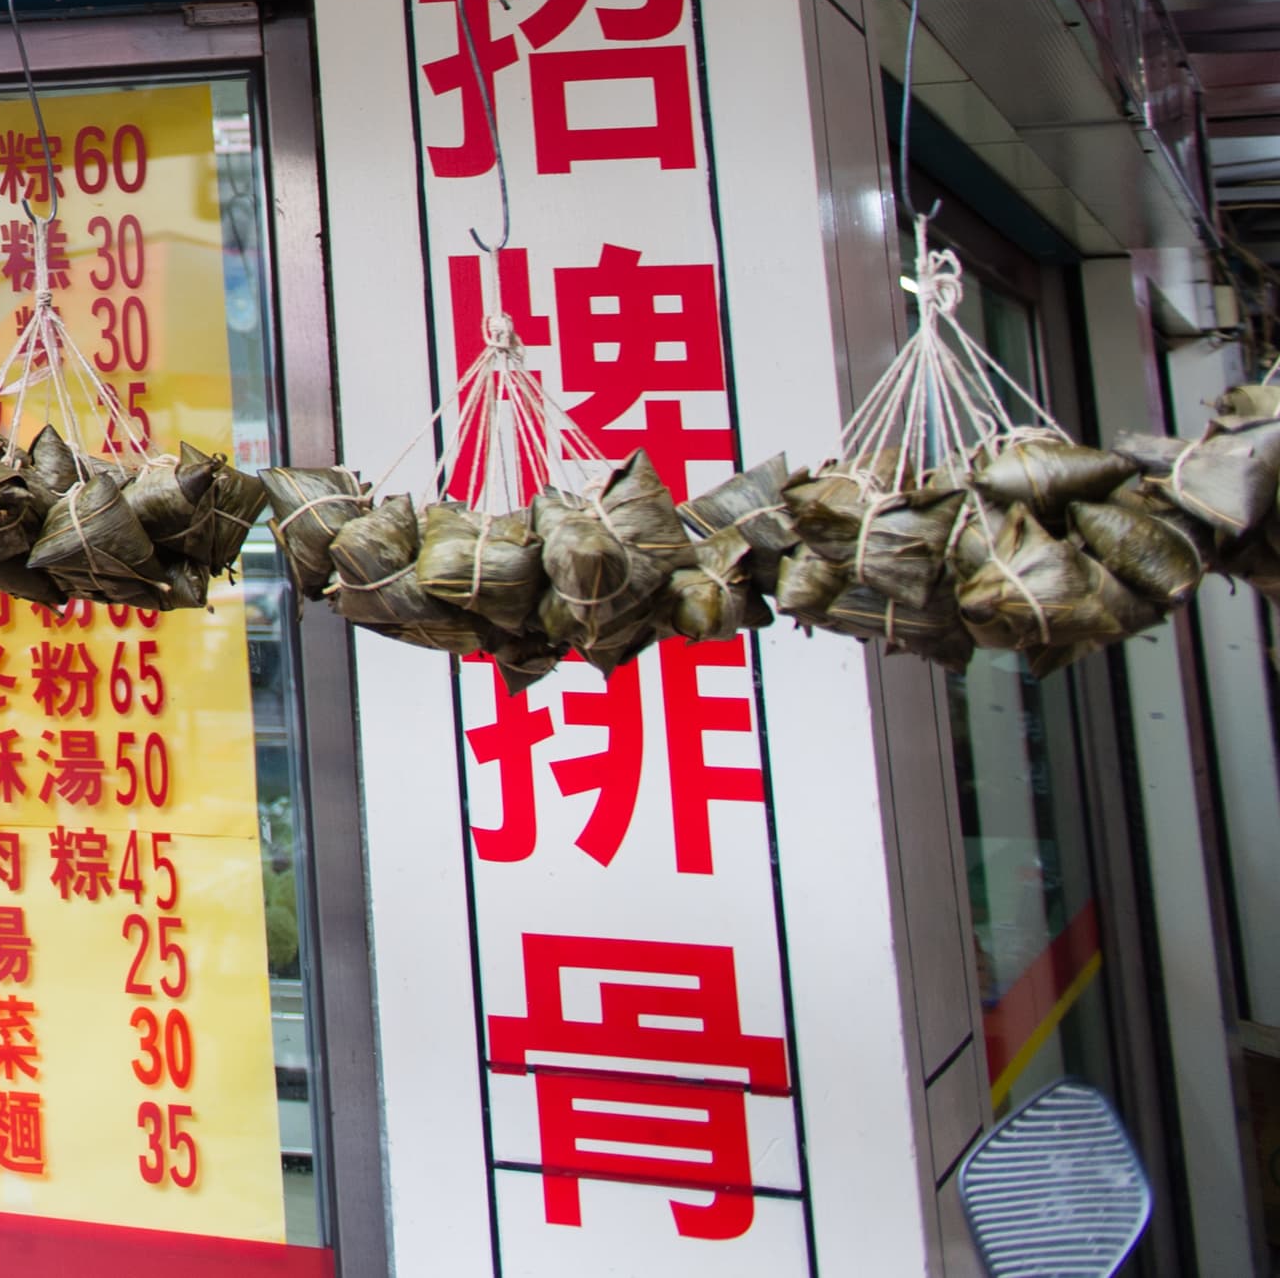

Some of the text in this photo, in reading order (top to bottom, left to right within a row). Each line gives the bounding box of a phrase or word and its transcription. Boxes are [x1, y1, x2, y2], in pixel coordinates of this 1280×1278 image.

[74, 124, 148, 196] 60
[89, 213, 145, 291] 30
[91, 295, 149, 372] 30
[96, 381, 152, 454] 25
[109, 640, 165, 716] 65
[115, 730, 170, 808] 50
[118, 828, 178, 911] 45
[122, 913, 189, 999] 25
[131, 1006, 193, 1090] 30
[138, 1101, 198, 1189] 35
